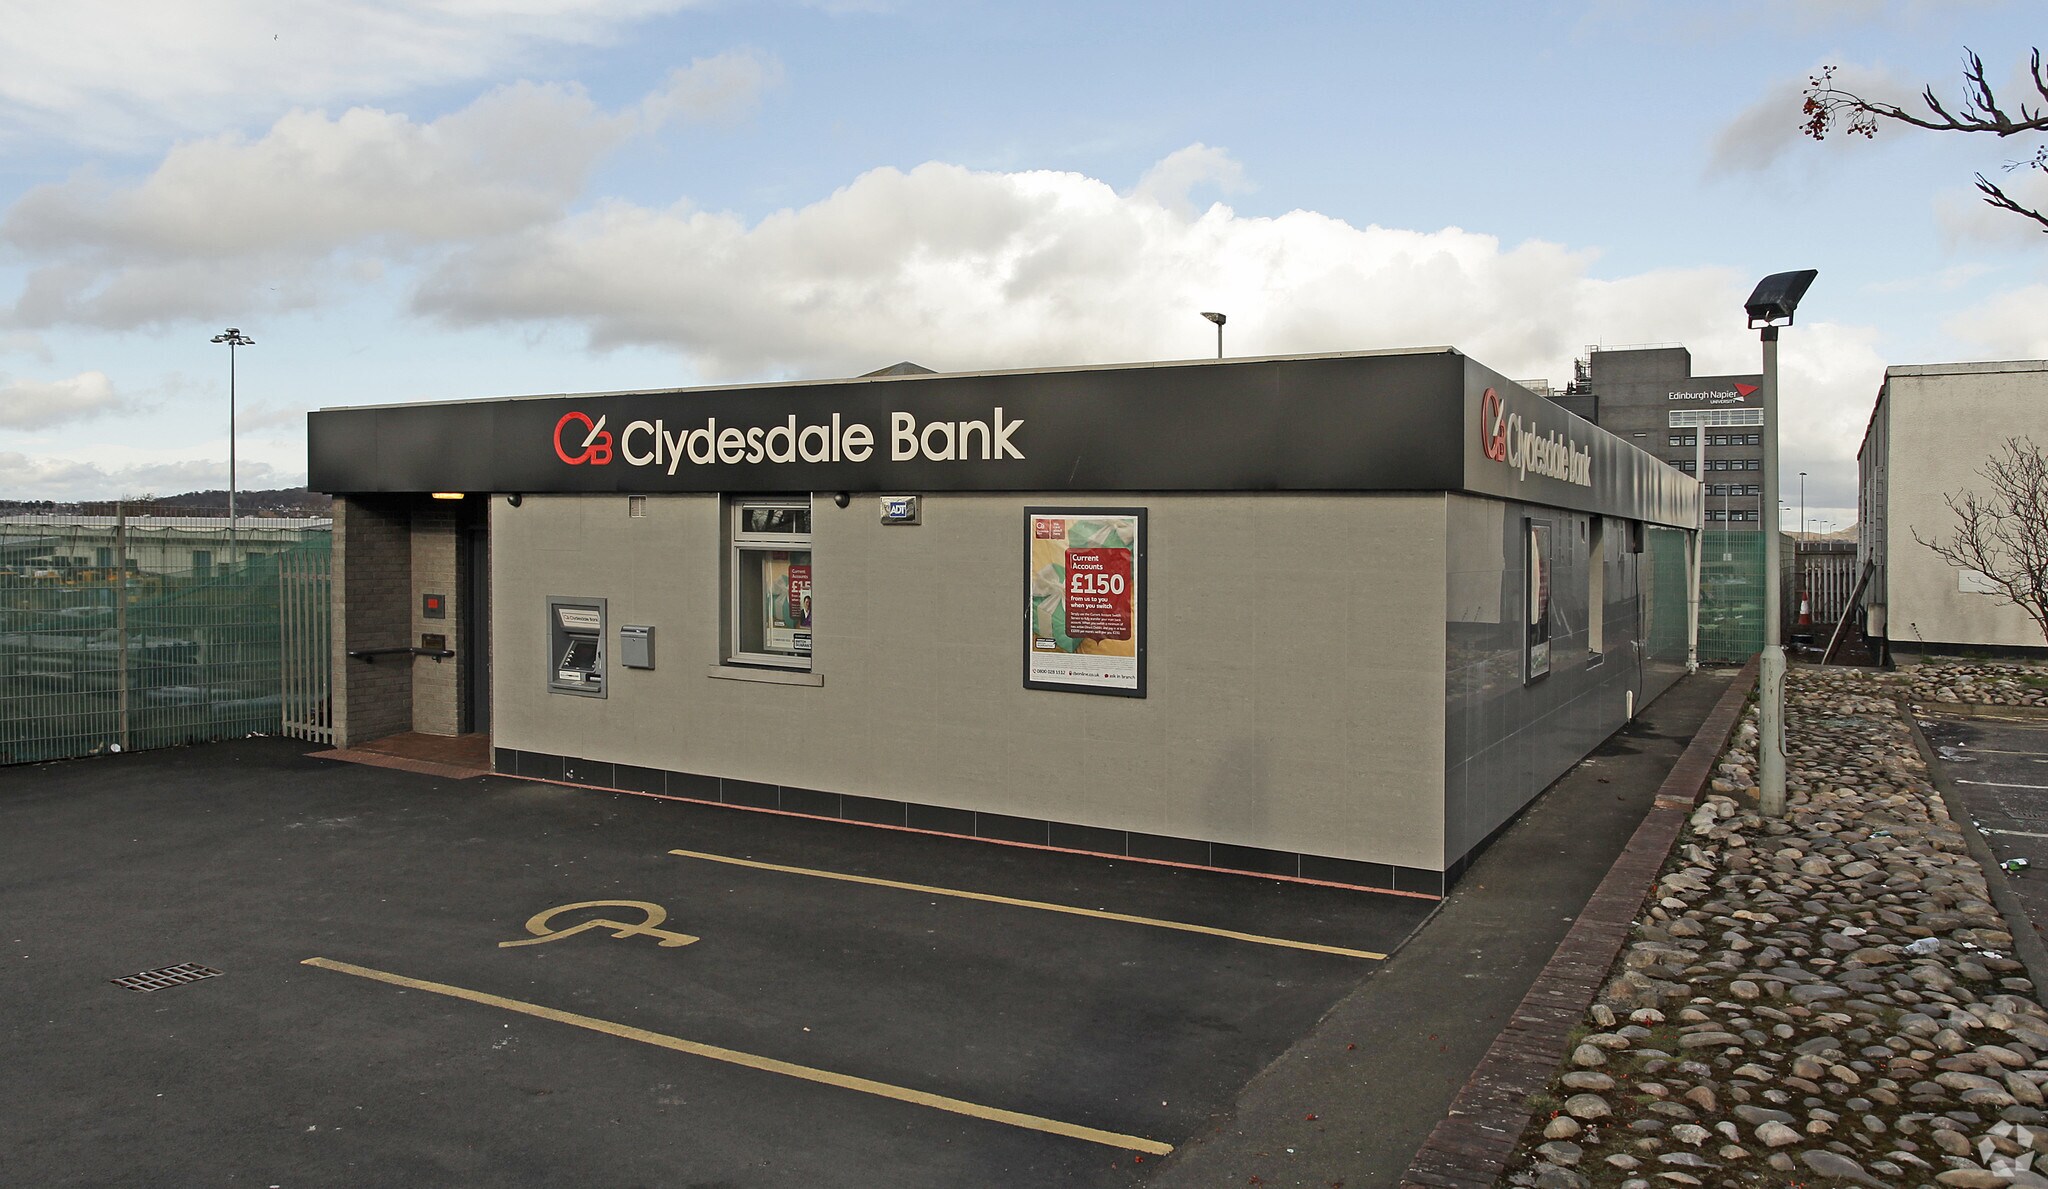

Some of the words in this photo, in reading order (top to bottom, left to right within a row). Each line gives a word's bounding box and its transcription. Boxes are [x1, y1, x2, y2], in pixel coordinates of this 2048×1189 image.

[1668, 391, 1709, 400] Edinburgh
[1710, 390, 1738, 400] Napier
[621, 413, 875, 476] Clydesdale
[891, 406, 1026, 462] Bank
[1506, 412, 1569, 482] Clydesdale
[1569, 439, 1592, 487] Bank
[890, 504, 906, 515] ADT
[1072, 554, 1099, 562] Current
[1072, 562, 1103, 570] Accounts
[791, 580, 811, 593] £15
[1070, 573, 1125, 595] £150
